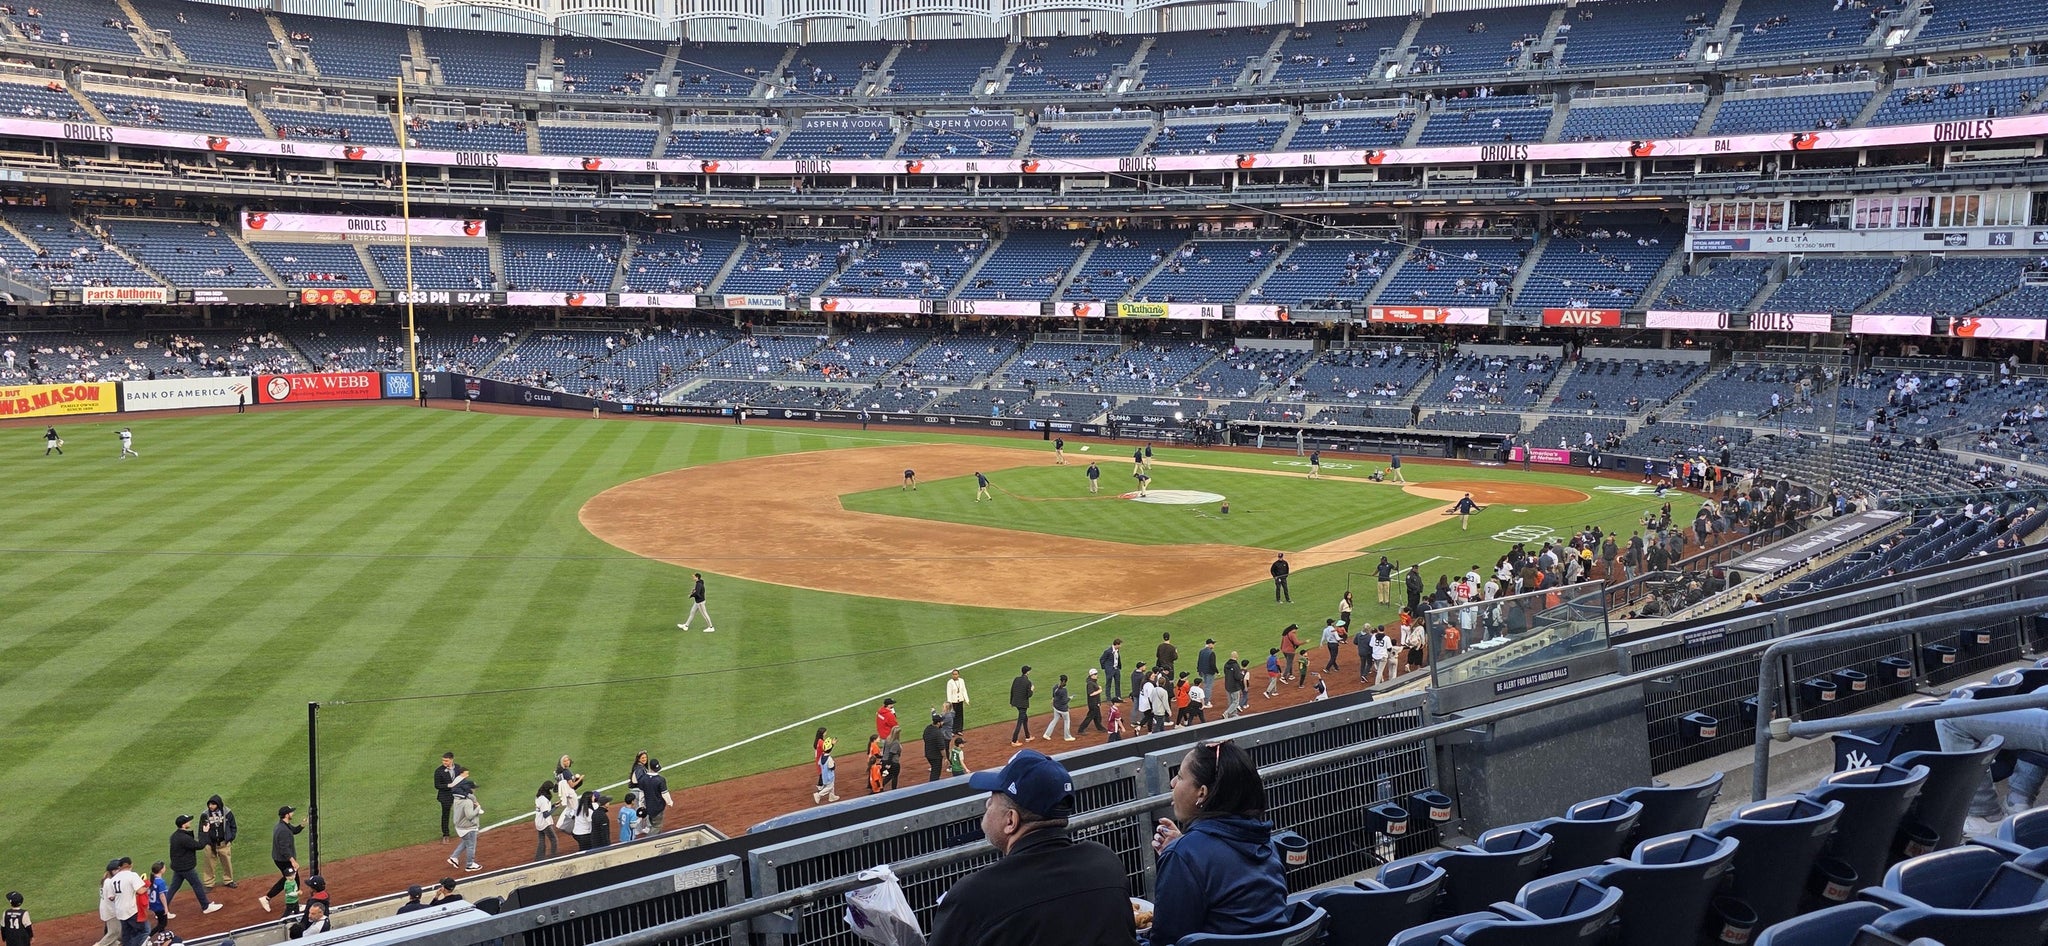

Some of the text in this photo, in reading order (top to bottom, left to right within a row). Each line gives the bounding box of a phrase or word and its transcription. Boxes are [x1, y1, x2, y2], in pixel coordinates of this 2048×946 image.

[806, 120, 884, 128] ASPEN VODKA
[927, 119, 1008, 127] ASPEN VODKA
[63, 123, 114, 142] ORIOLES
[1933, 120, 1994, 141] ORIOLES
[281, 143, 296, 154] BAL
[1714, 139, 1731, 152] BAL
[1480, 144, 1528, 161] ORIOLES
[456, 152, 498, 167] ORIOLES
[1118, 157, 1157, 172] ORIOLES
[1303, 153, 1317, 165] BAL
[646, 161, 659, 171] BAL
[795, 161, 832, 174] ORIOLES
[966, 162, 979, 172] BAL
[347, 219, 387, 232] ORIOLES
[378, 235, 423, 243] CLUBHUSE
[87, 288, 163, 300] Parts Authority
[430, 293, 450, 303] PM
[647, 295, 661, 306] BAL
[747, 298, 783, 306] AMAZING
[1122, 303, 1165, 315] Nathan's
[1201, 307, 1215, 318] BAL
[1560, 310, 1602, 325] AVIS
[292, 375, 370, 390] F.W. WEBB
[422, 374, 436, 383] 314
[126, 388, 226, 400] BANK OF AMERICA
[391, 387, 408, 395] LIFE
[1109, 414, 1131, 422] StubHub
[1374, 639, 1385, 648] 99
[1496, 667, 1568, 691] BE ALERT FOR BATS AND/OR BALLS
[621, 814, 627, 825] 9
[113, 880, 122, 894] 11
[9, 918, 20, 929] 14
